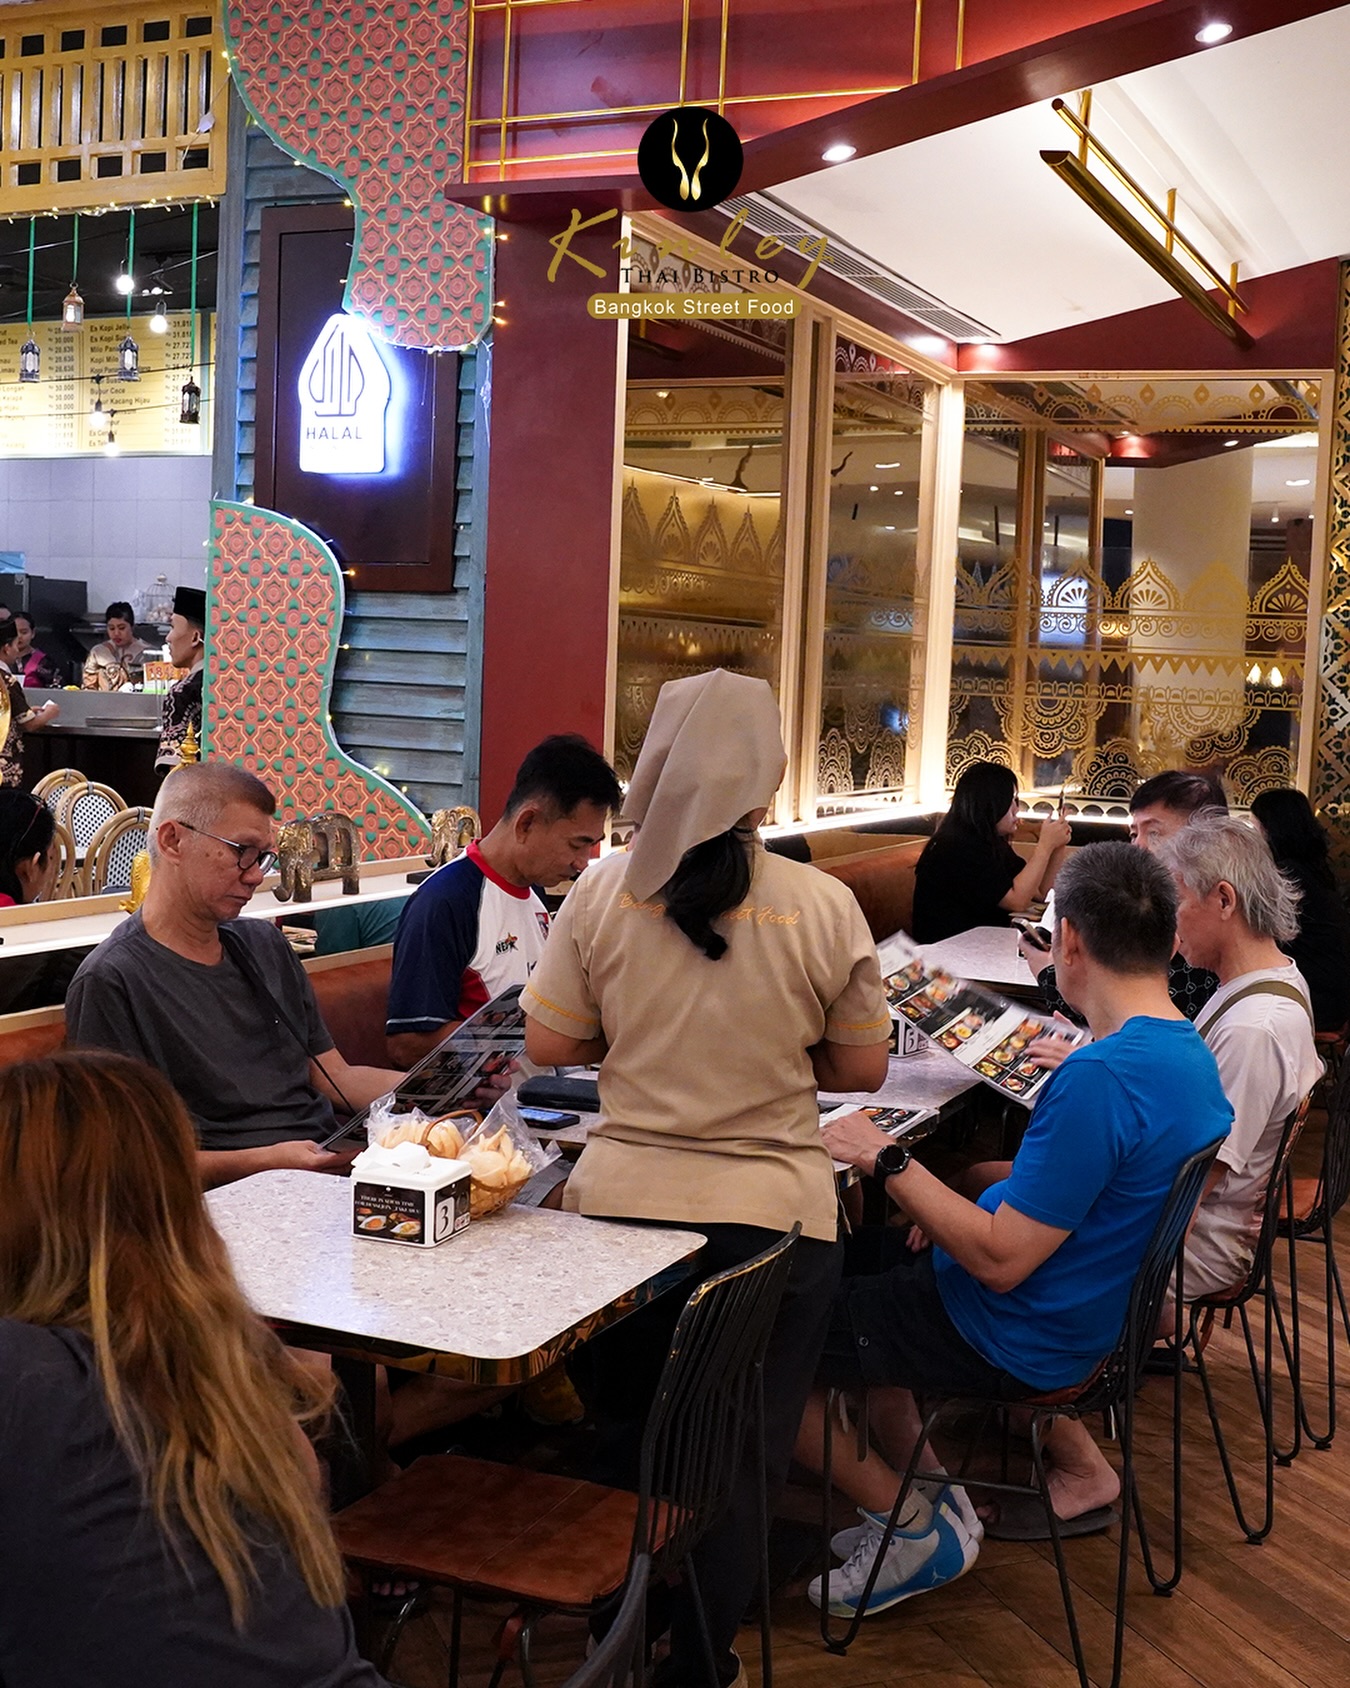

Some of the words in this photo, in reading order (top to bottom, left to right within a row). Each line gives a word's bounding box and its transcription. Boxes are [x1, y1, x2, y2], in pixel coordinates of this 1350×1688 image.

[306, 426, 363, 440] HALAL
[618, 892, 668, 918] Bang
[757, 905, 801, 926] Food
[439, 1205, 449, 1235] 3
